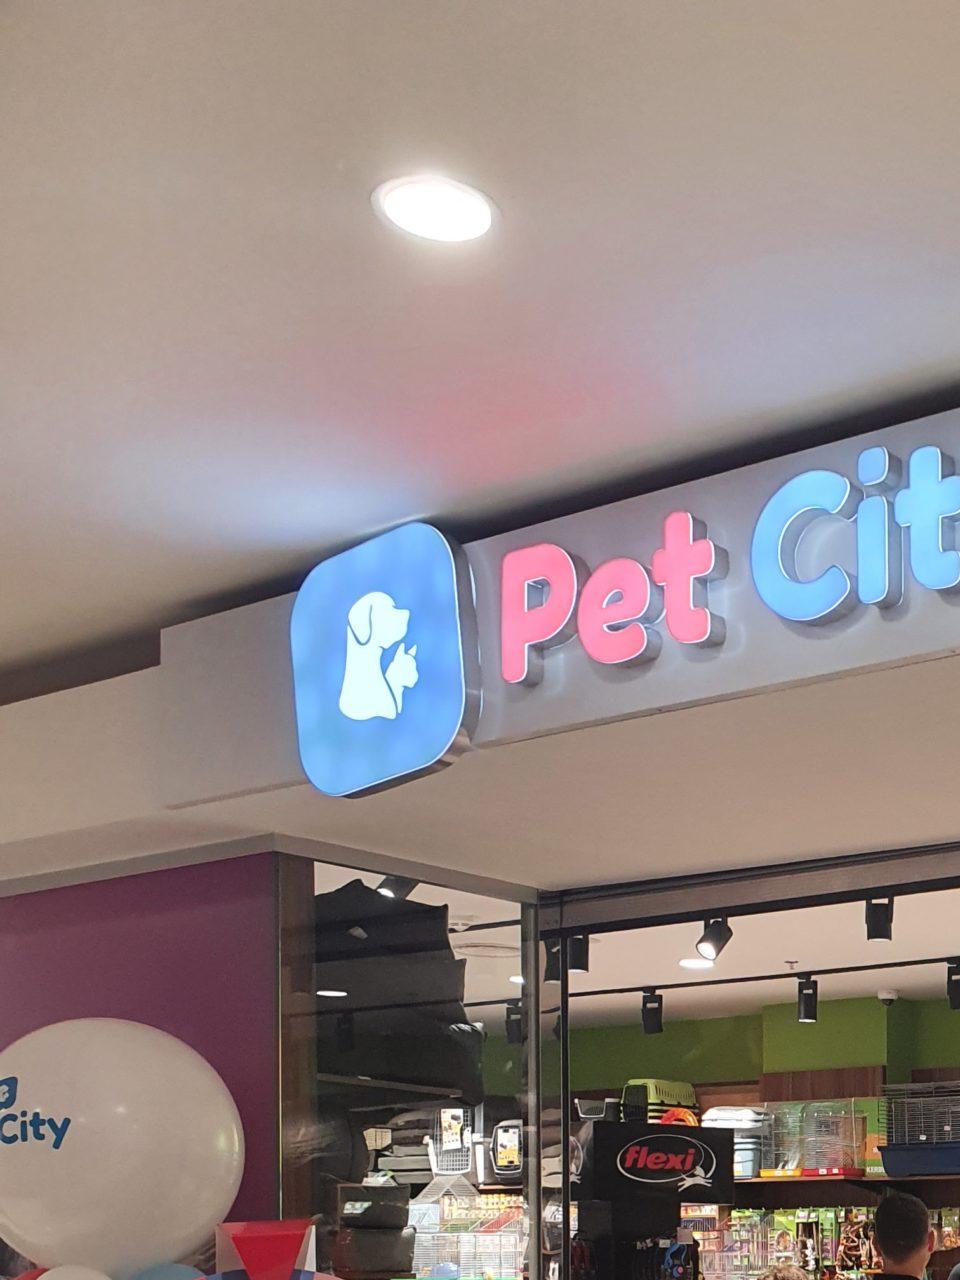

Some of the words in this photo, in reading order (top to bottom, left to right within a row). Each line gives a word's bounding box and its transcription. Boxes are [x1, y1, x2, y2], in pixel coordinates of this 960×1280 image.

[501, 510, 717, 684] Pet
[0, 1110, 71, 1149] City
[624, 1145, 696, 1171] flexi
